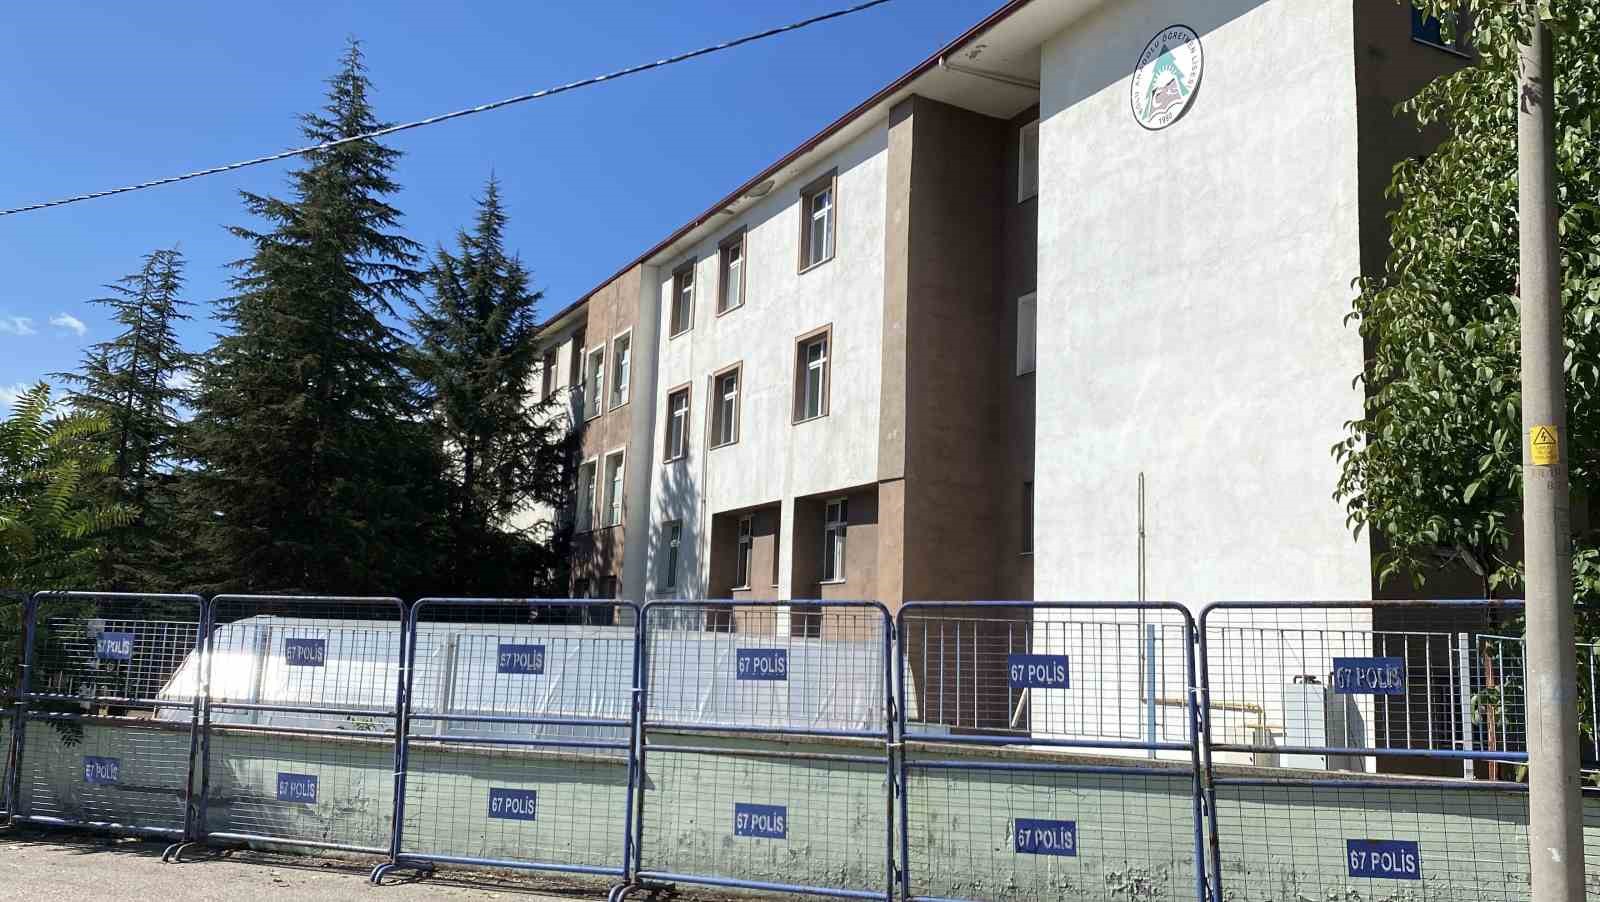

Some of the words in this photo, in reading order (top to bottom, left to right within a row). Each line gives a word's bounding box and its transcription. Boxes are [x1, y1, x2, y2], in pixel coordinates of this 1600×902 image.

[513, 649, 543, 669] POLİS
[739, 657, 750, 672] 67
[753, 652, 785, 673] POLİS
[1011, 664, 1024, 681] 67
[1028, 660, 1065, 682] POLİS
[1355, 663, 1401, 689] POLİS
[290, 779, 315, 798] POLİS
[492, 797, 503, 812] 67
[505, 795, 534, 814] POLİS
[737, 813, 749, 829] 67
[751, 811, 784, 832] POLİS
[1018, 829, 1031, 847] 67
[1034, 826, 1073, 849] POLİS
[1350, 850, 1366, 869] 67
[1370, 848, 1415, 873] POLİS
